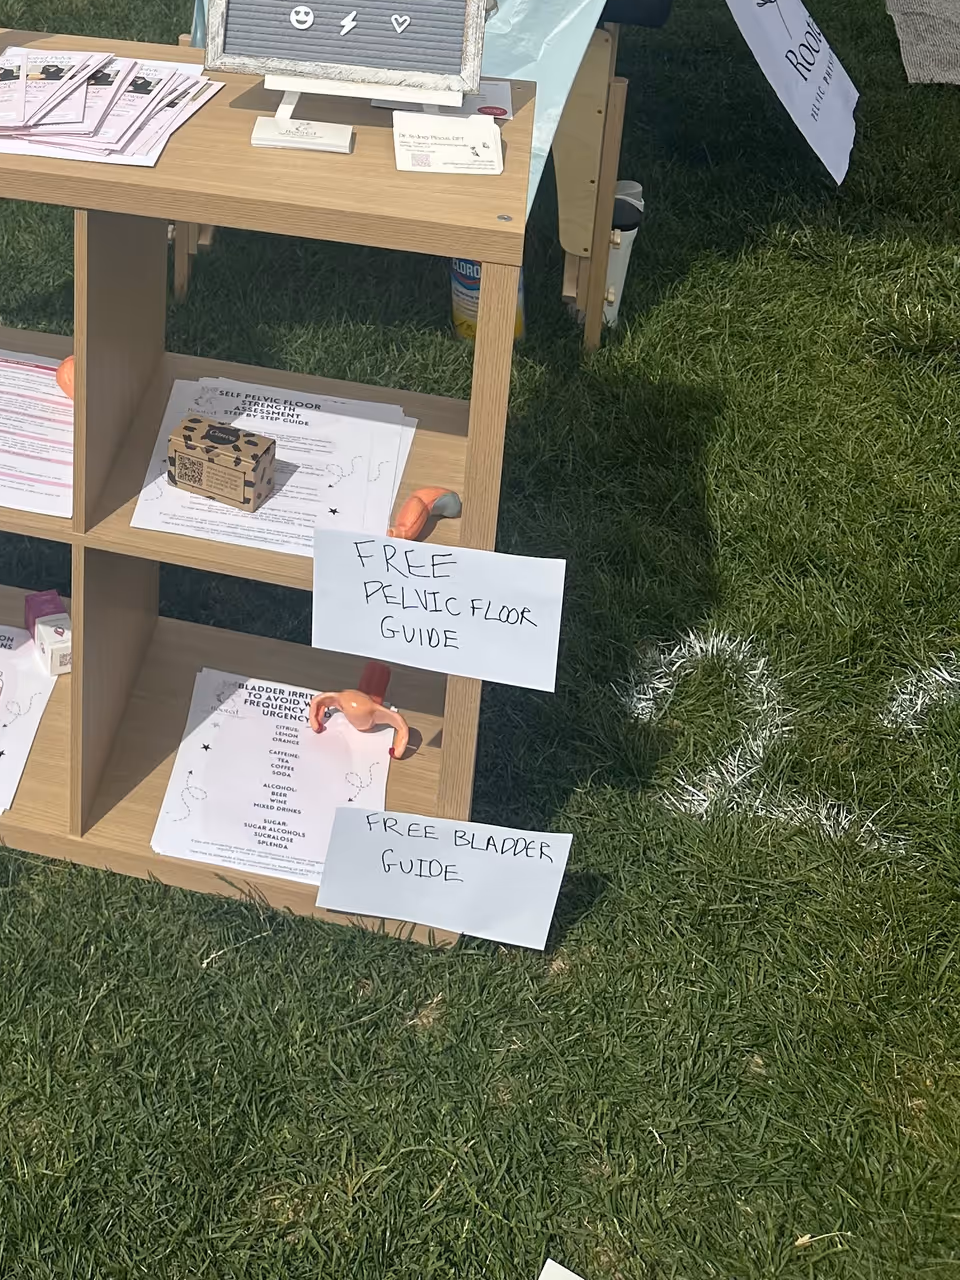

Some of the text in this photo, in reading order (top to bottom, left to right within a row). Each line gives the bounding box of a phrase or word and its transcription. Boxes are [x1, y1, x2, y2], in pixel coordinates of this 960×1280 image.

[452, 257, 481, 279] CLORO
[219, 390, 322, 410] SELF PELVIC FLOOR
[241, 400, 296, 412] STRENGTH
[233, 405, 302, 419] ASSESSMENT
[283, 418, 310, 426] GUIDE
[353, 540, 457, 578] FREE
[363, 581, 538, 627] PELVIC FLOOR
[380, 616, 460, 650] GUIDE
[238, 682, 285, 696] BLADDER
[247, 691, 262, 700] TO
[265, 695, 300, 706] AVOID
[243, 698, 306, 714] FREQUENCY
[262, 708, 311, 723] URGENCY
[272, 737, 300, 745] ORANGE
[270, 763, 295, 771] COFFEE
[272, 770, 292, 778] SODA
[270, 797, 287, 805] WINE
[253, 802, 302, 815] MIXED DRINKS
[243, 822, 306, 838] SUGAR ALCOHOLS
[253, 831, 294, 843] SUCRALOSE
[257, 839, 289, 850] SPLENDA
[366, 812, 553, 863] FREE BLADDER
[381, 848, 464, 882] GUIDE
